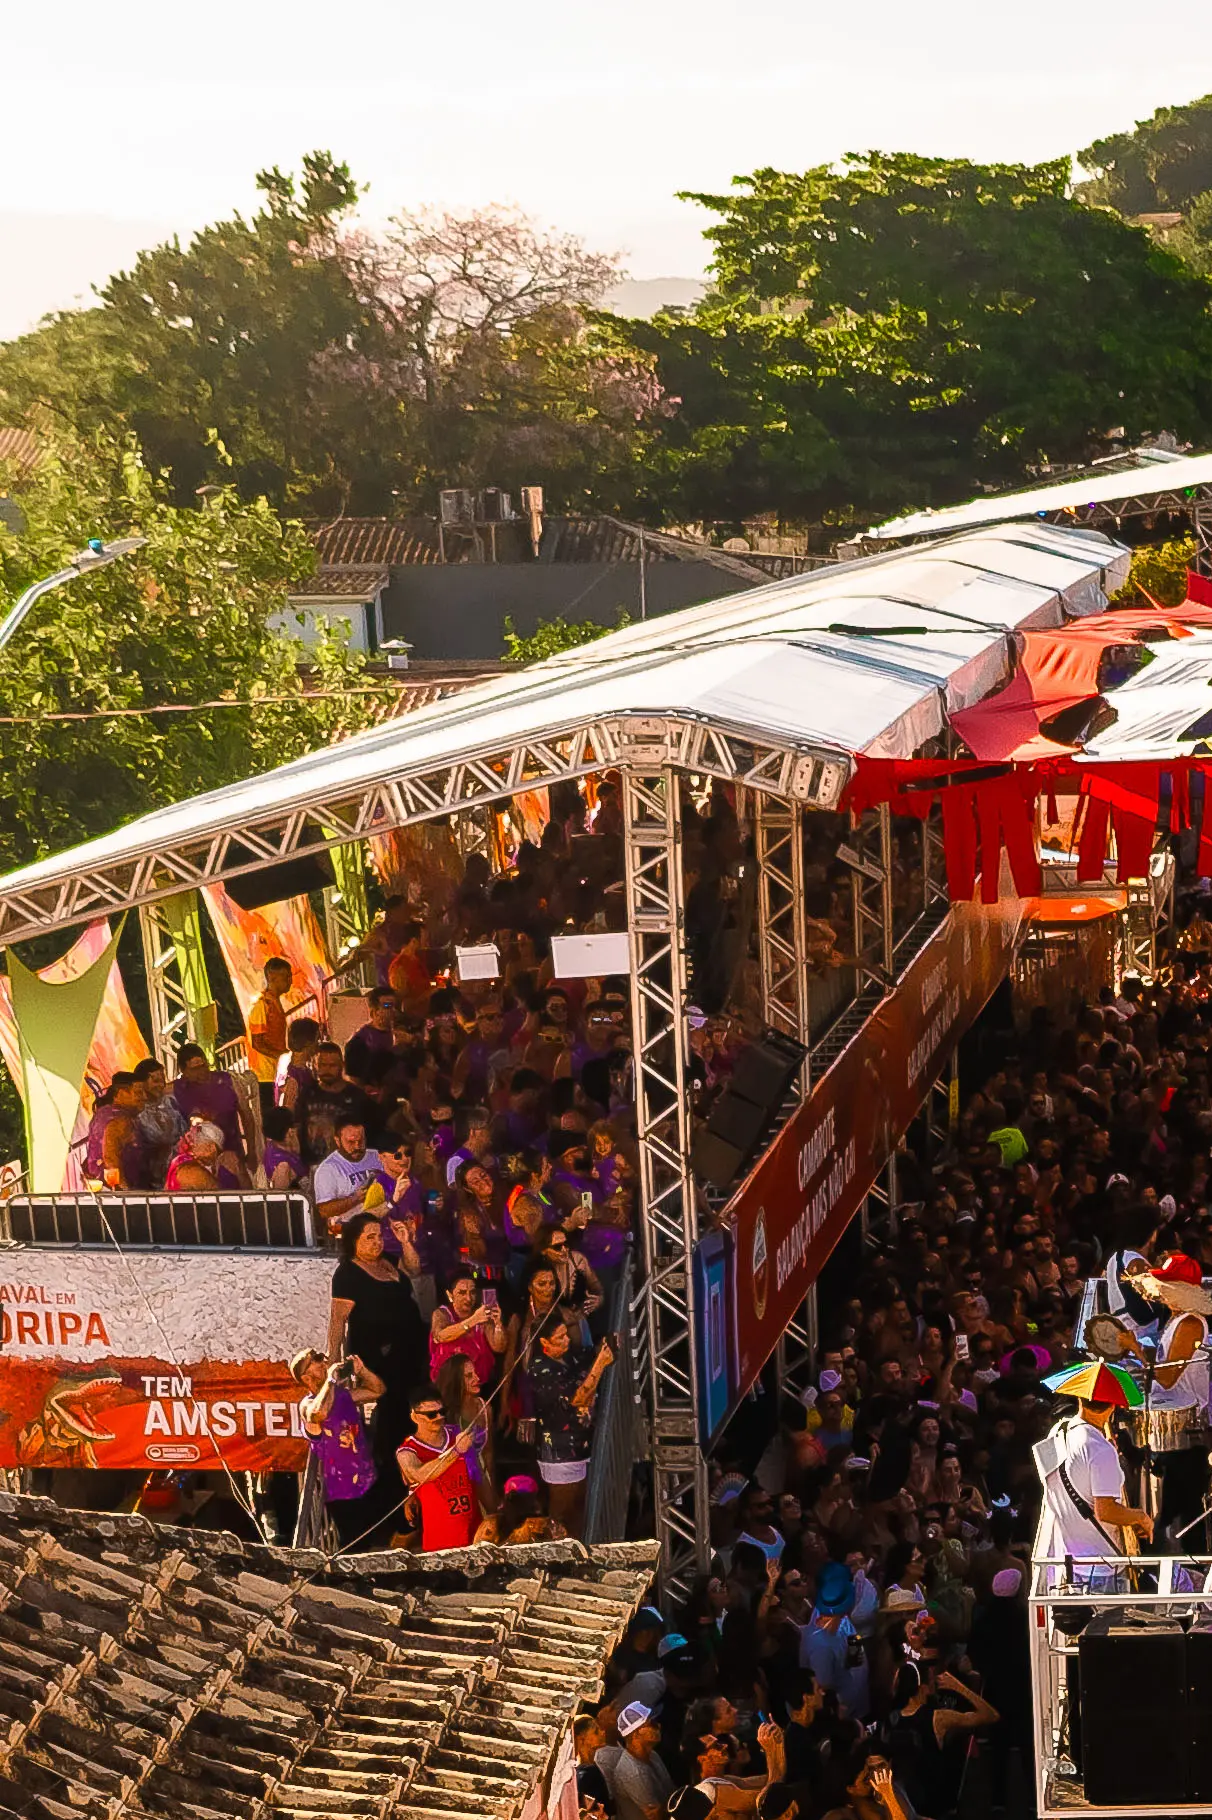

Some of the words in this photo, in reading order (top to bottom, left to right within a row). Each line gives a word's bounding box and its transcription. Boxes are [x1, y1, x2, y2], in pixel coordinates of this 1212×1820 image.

[55, 1293, 76, 1305] EM
[141, 1376, 194, 1398] TEM
[144, 1400, 305, 1437] AMSTEL
[448, 1495, 471, 1516] 29
